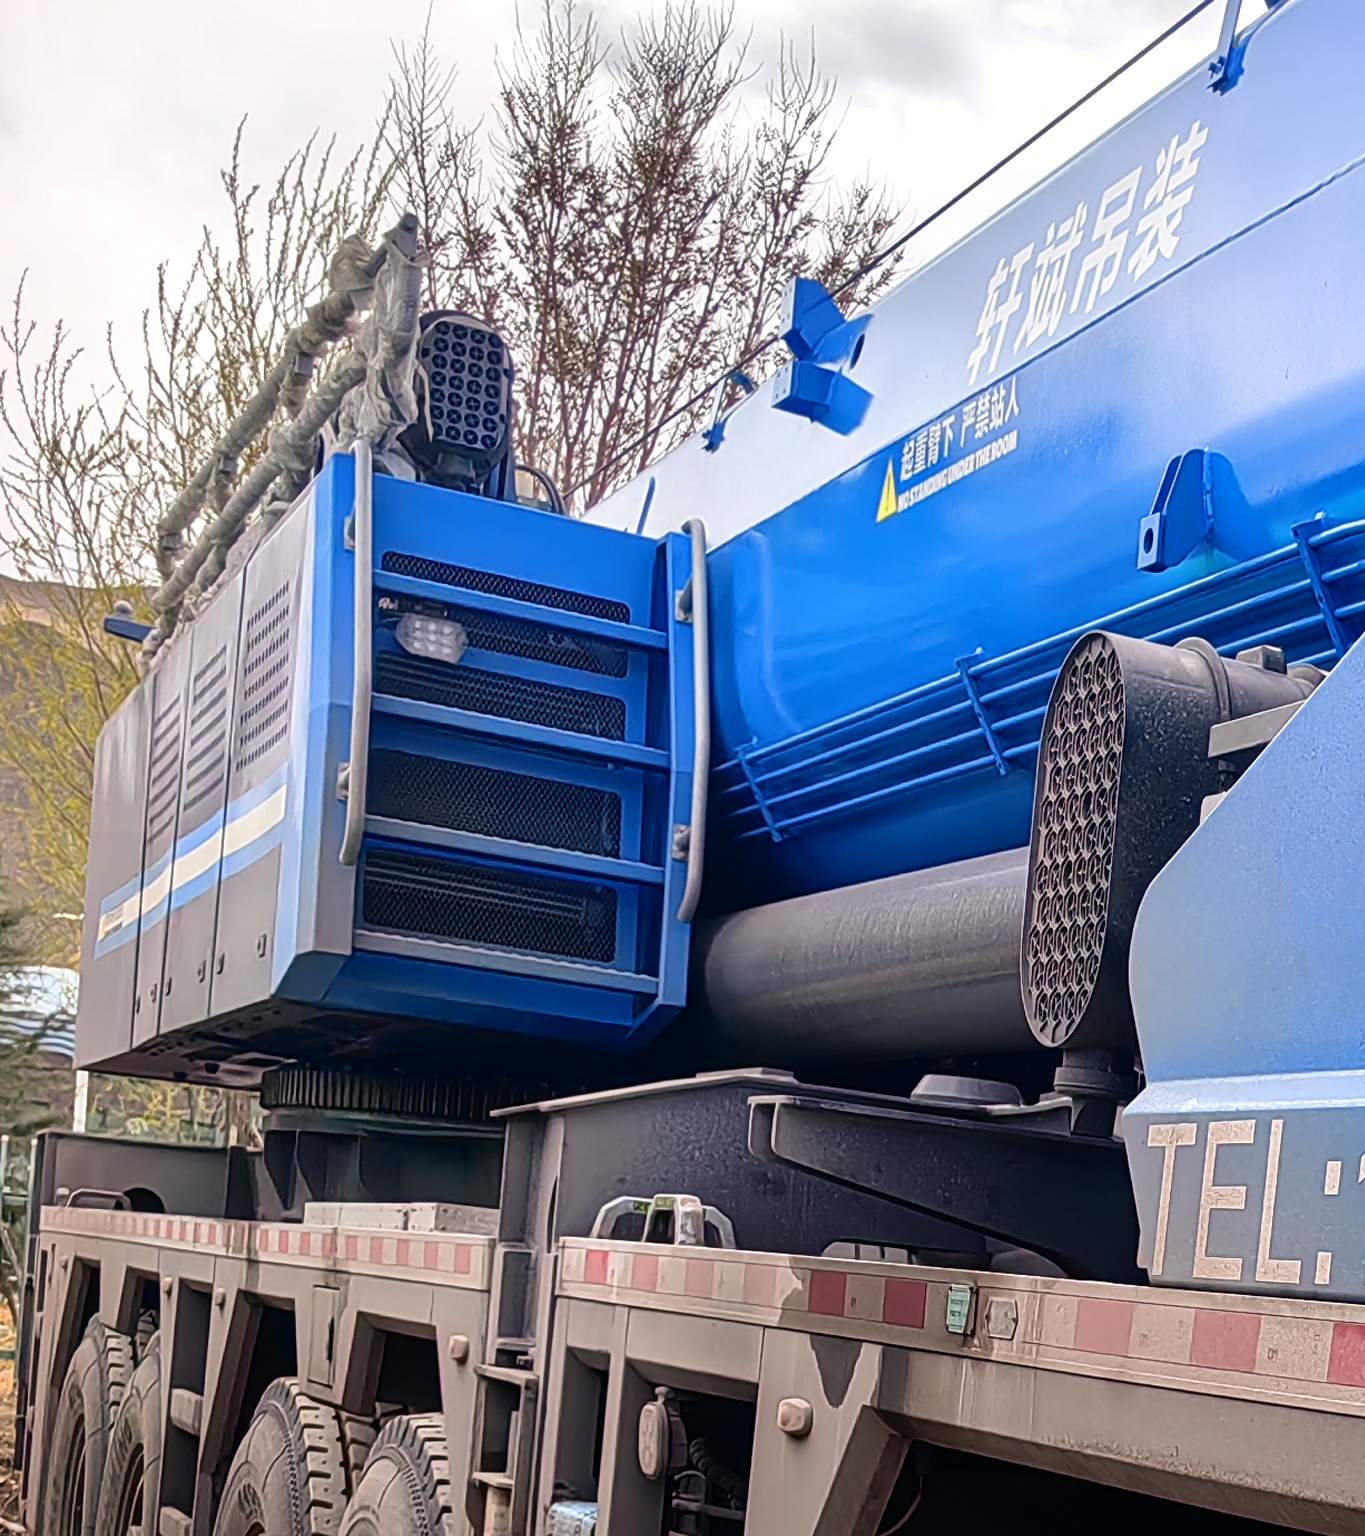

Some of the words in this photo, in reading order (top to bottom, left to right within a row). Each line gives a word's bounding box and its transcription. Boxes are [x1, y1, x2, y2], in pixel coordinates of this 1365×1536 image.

[966, 119, 1210, 387] 轩斌吊装
[900, 415, 956, 482] 起重臂下
[960, 374, 1020, 448] 严禁站人
[909, 468, 949, 507] STANDING
[948, 453, 975, 485] UNDER
[975, 443, 991, 470] THE
[990, 429, 1018, 462] BOOM
